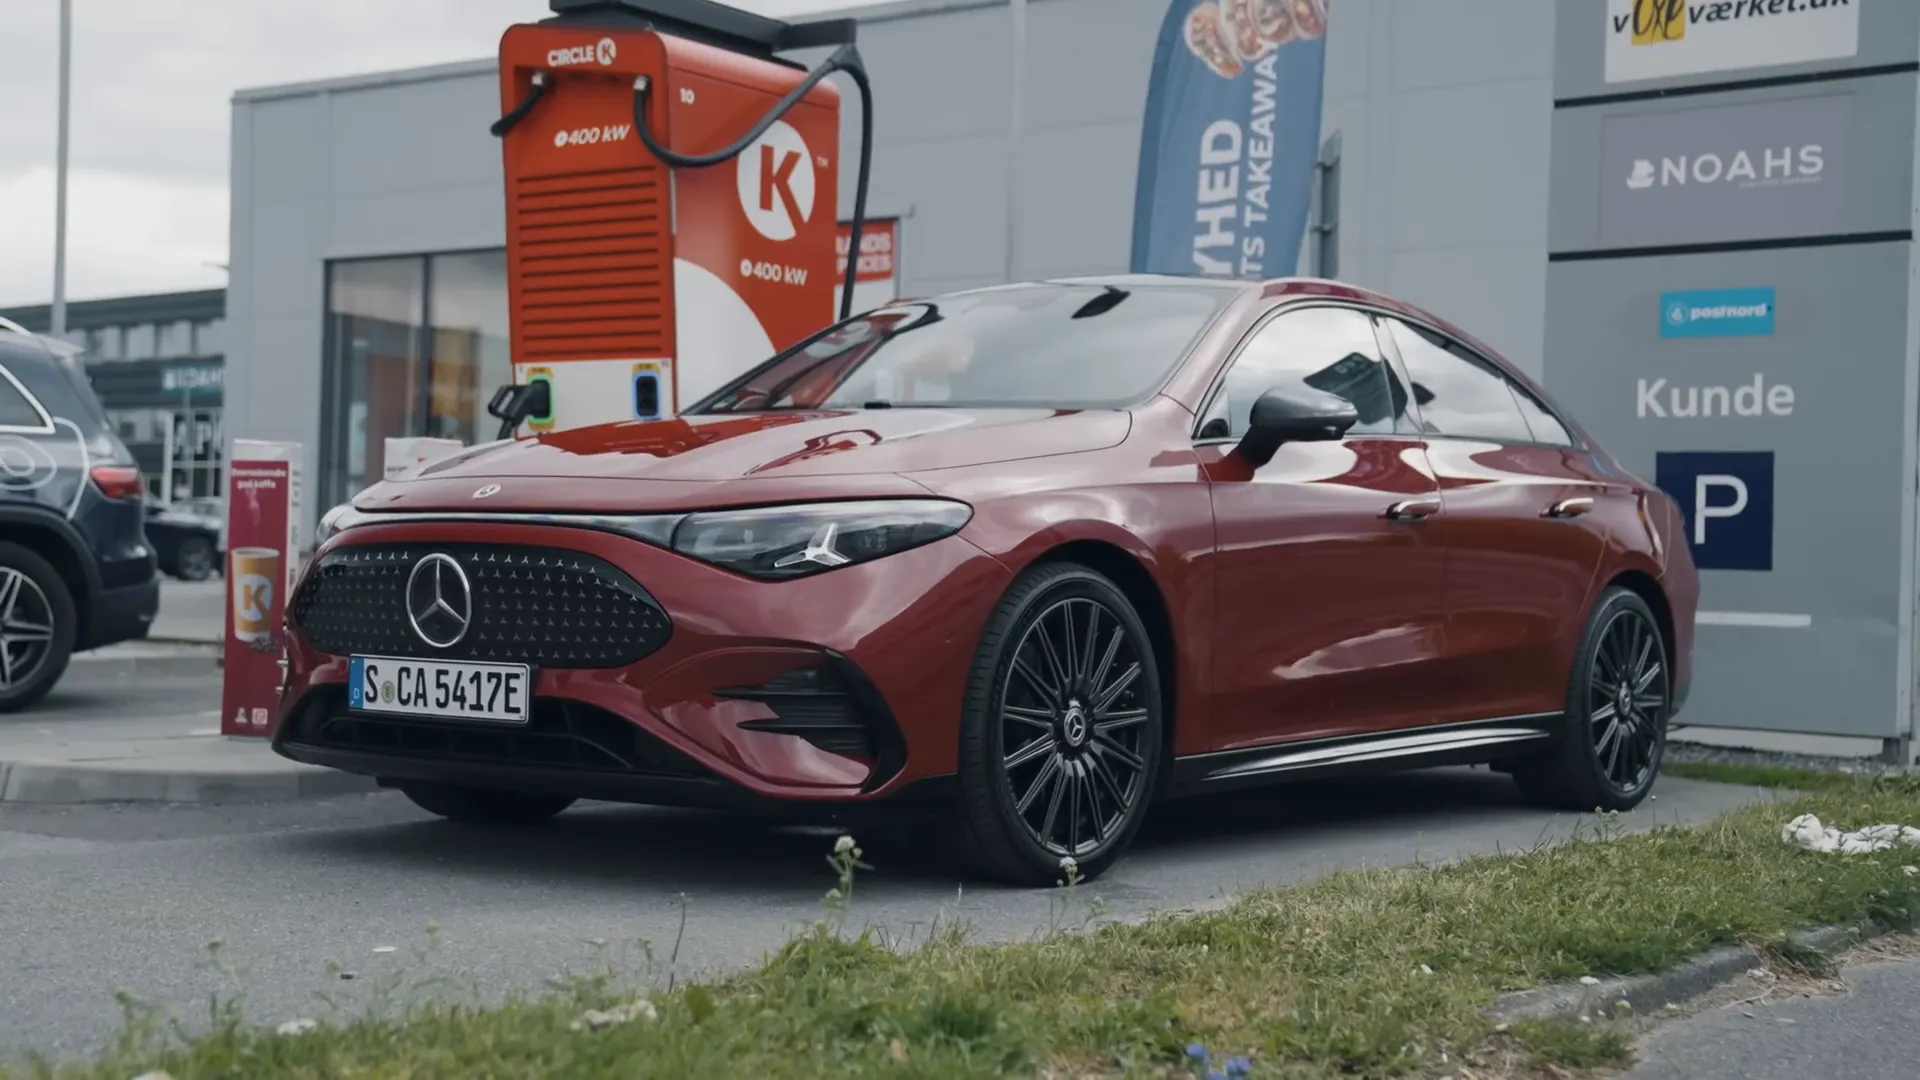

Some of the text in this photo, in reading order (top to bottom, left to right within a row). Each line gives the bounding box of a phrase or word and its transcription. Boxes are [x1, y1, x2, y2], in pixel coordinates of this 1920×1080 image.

[547, 40, 616, 67] CIRCLE K
[680, 88, 695, 104] 10
[568, 124, 631, 145] 400 kW
[1661, 145, 1824, 187] NOAHS
[757, 142, 808, 236] K
[754, 261, 807, 286] 400 kW
[1690, 303, 1767, 322] postnord
[1636, 373, 1795, 418] Kunde
[1694, 475, 1749, 544] P
[242, 582, 271, 621] K
[353, 687, 360, 699] D
[365, 664, 522, 714] S CA 5417E
